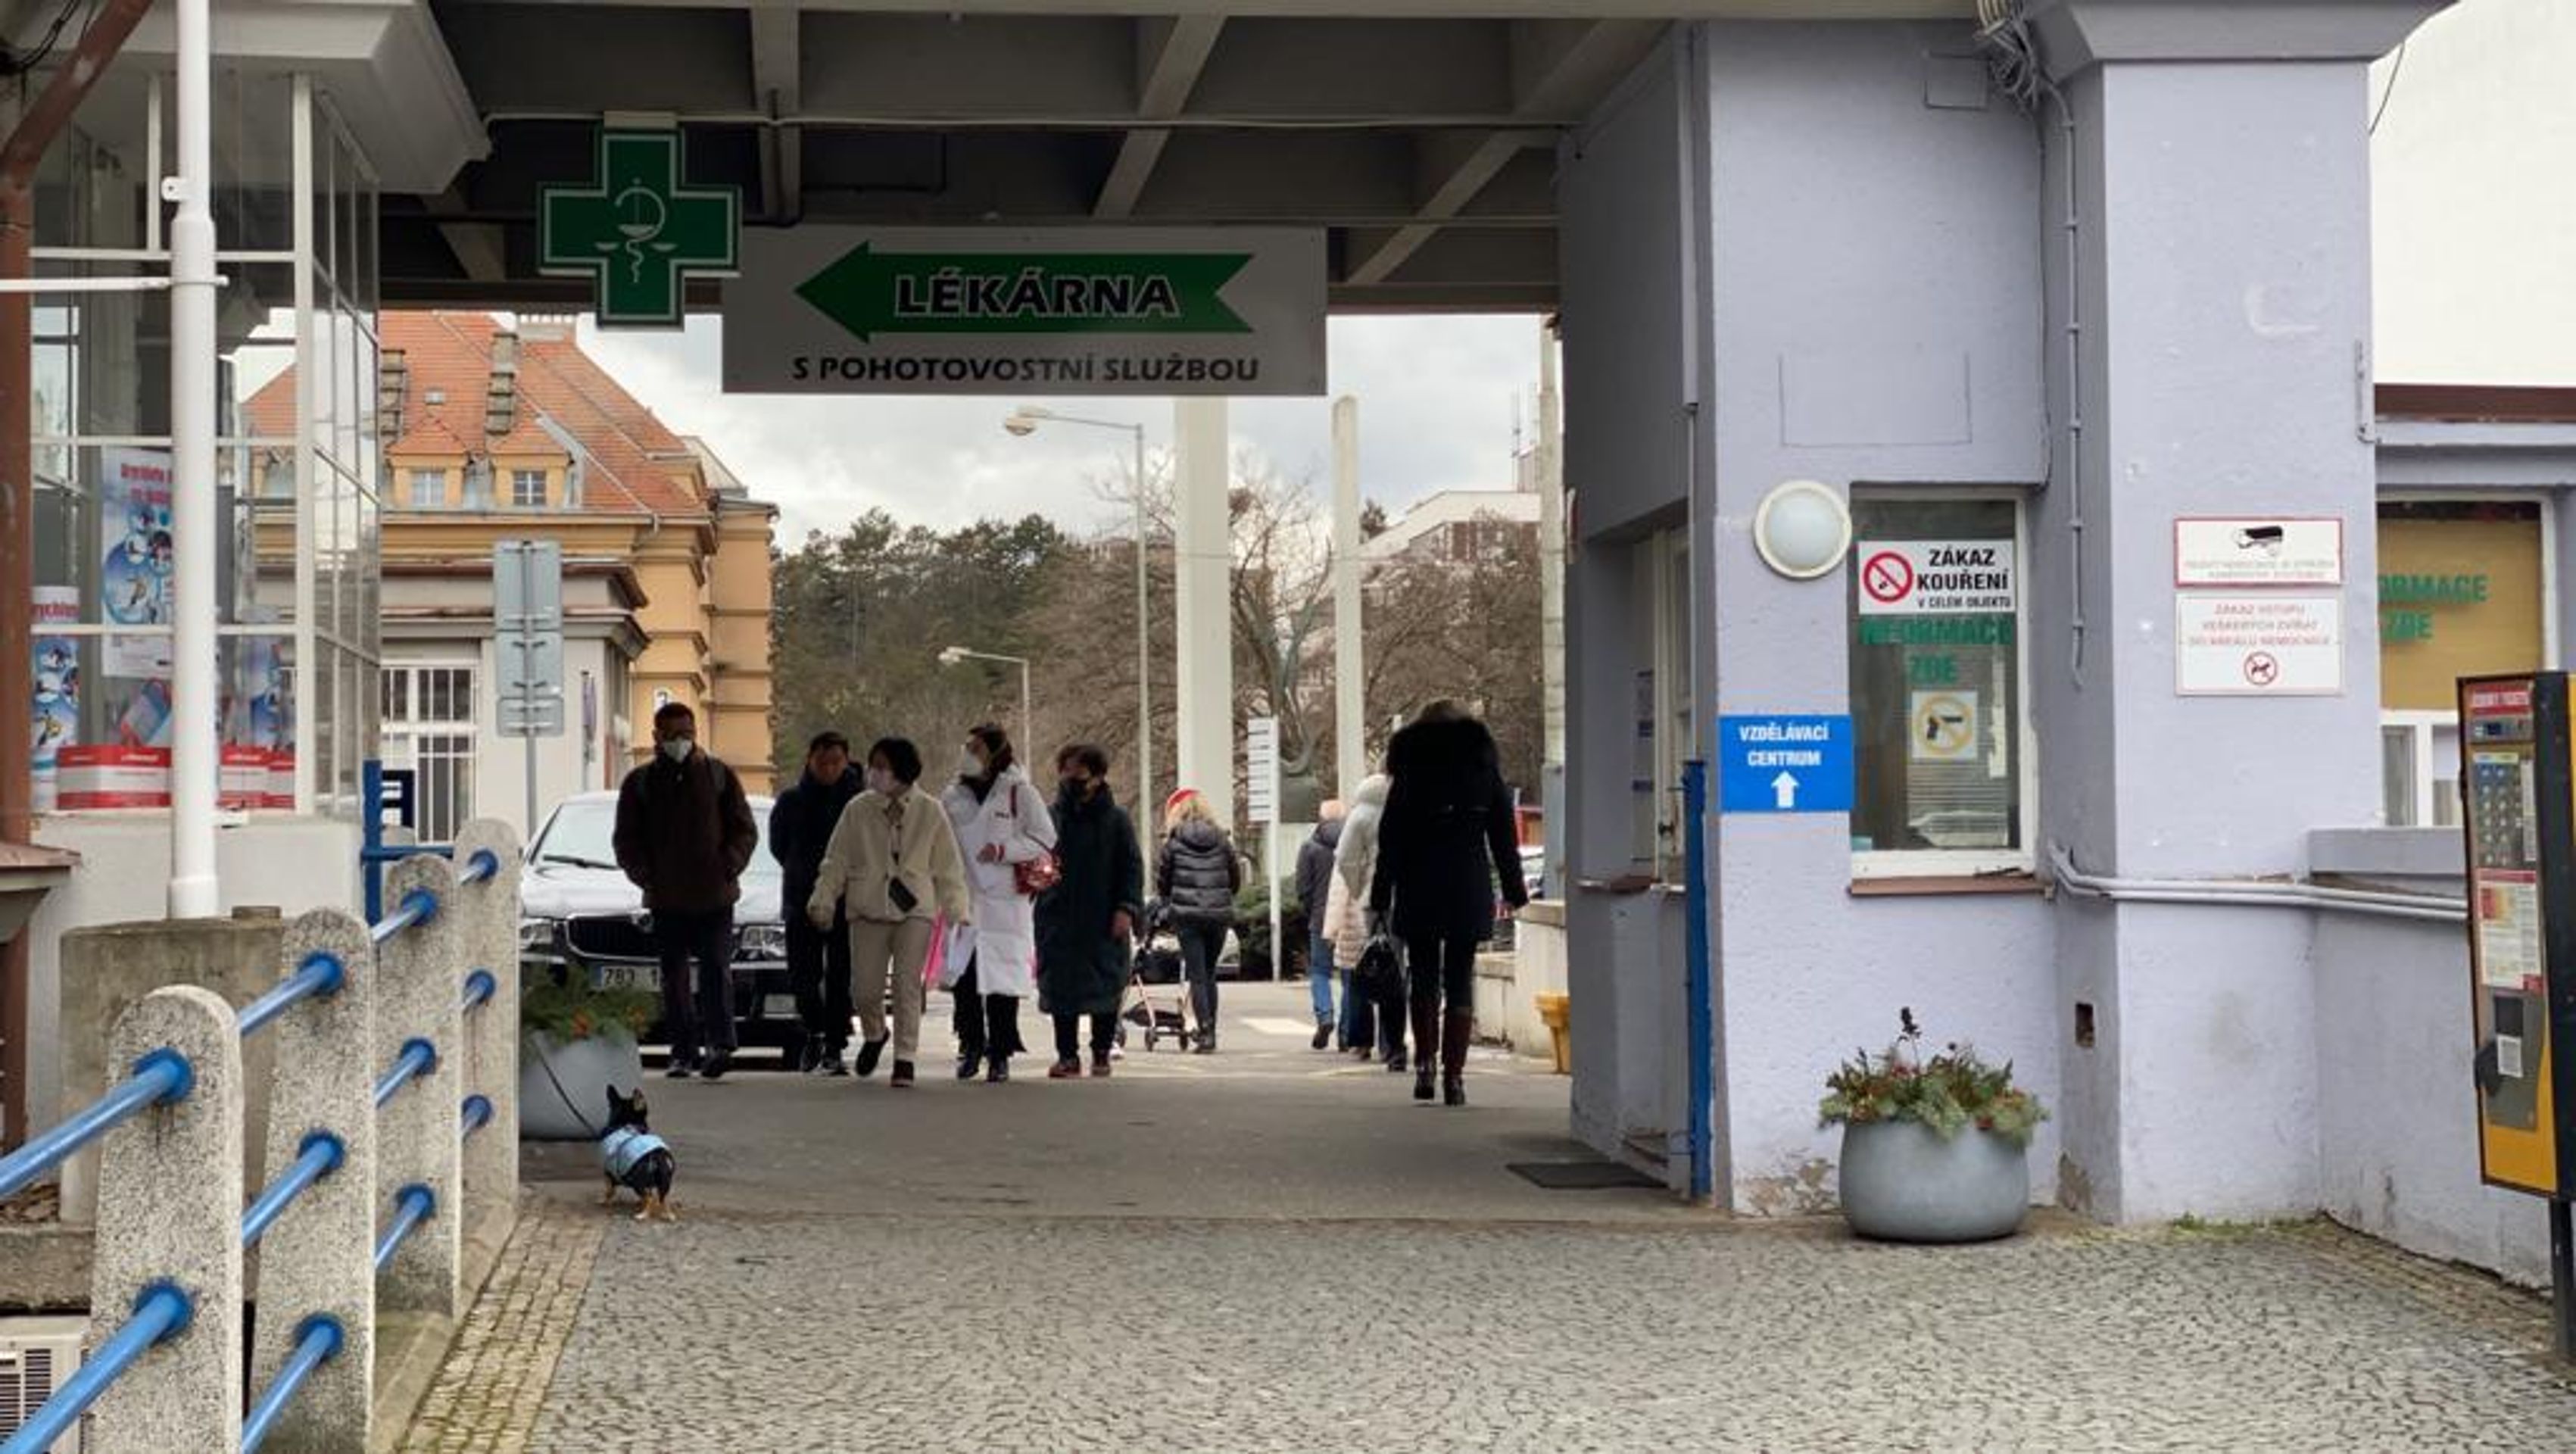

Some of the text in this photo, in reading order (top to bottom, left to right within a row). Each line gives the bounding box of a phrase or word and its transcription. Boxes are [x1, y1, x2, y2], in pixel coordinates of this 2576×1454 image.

[896, 267, 1178, 317] LÉKÁRNA
[793, 352, 1260, 382] S POHOTOVOSTNÍ SLUŽBOU
[1929, 545, 1995, 566] ZÁKAZ
[1916, 569, 2009, 590] KOUŘENÍ
[1739, 722, 1829, 741] VZDĚLÁVACÍ
[1748, 749, 1821, 766] CENTRUM
